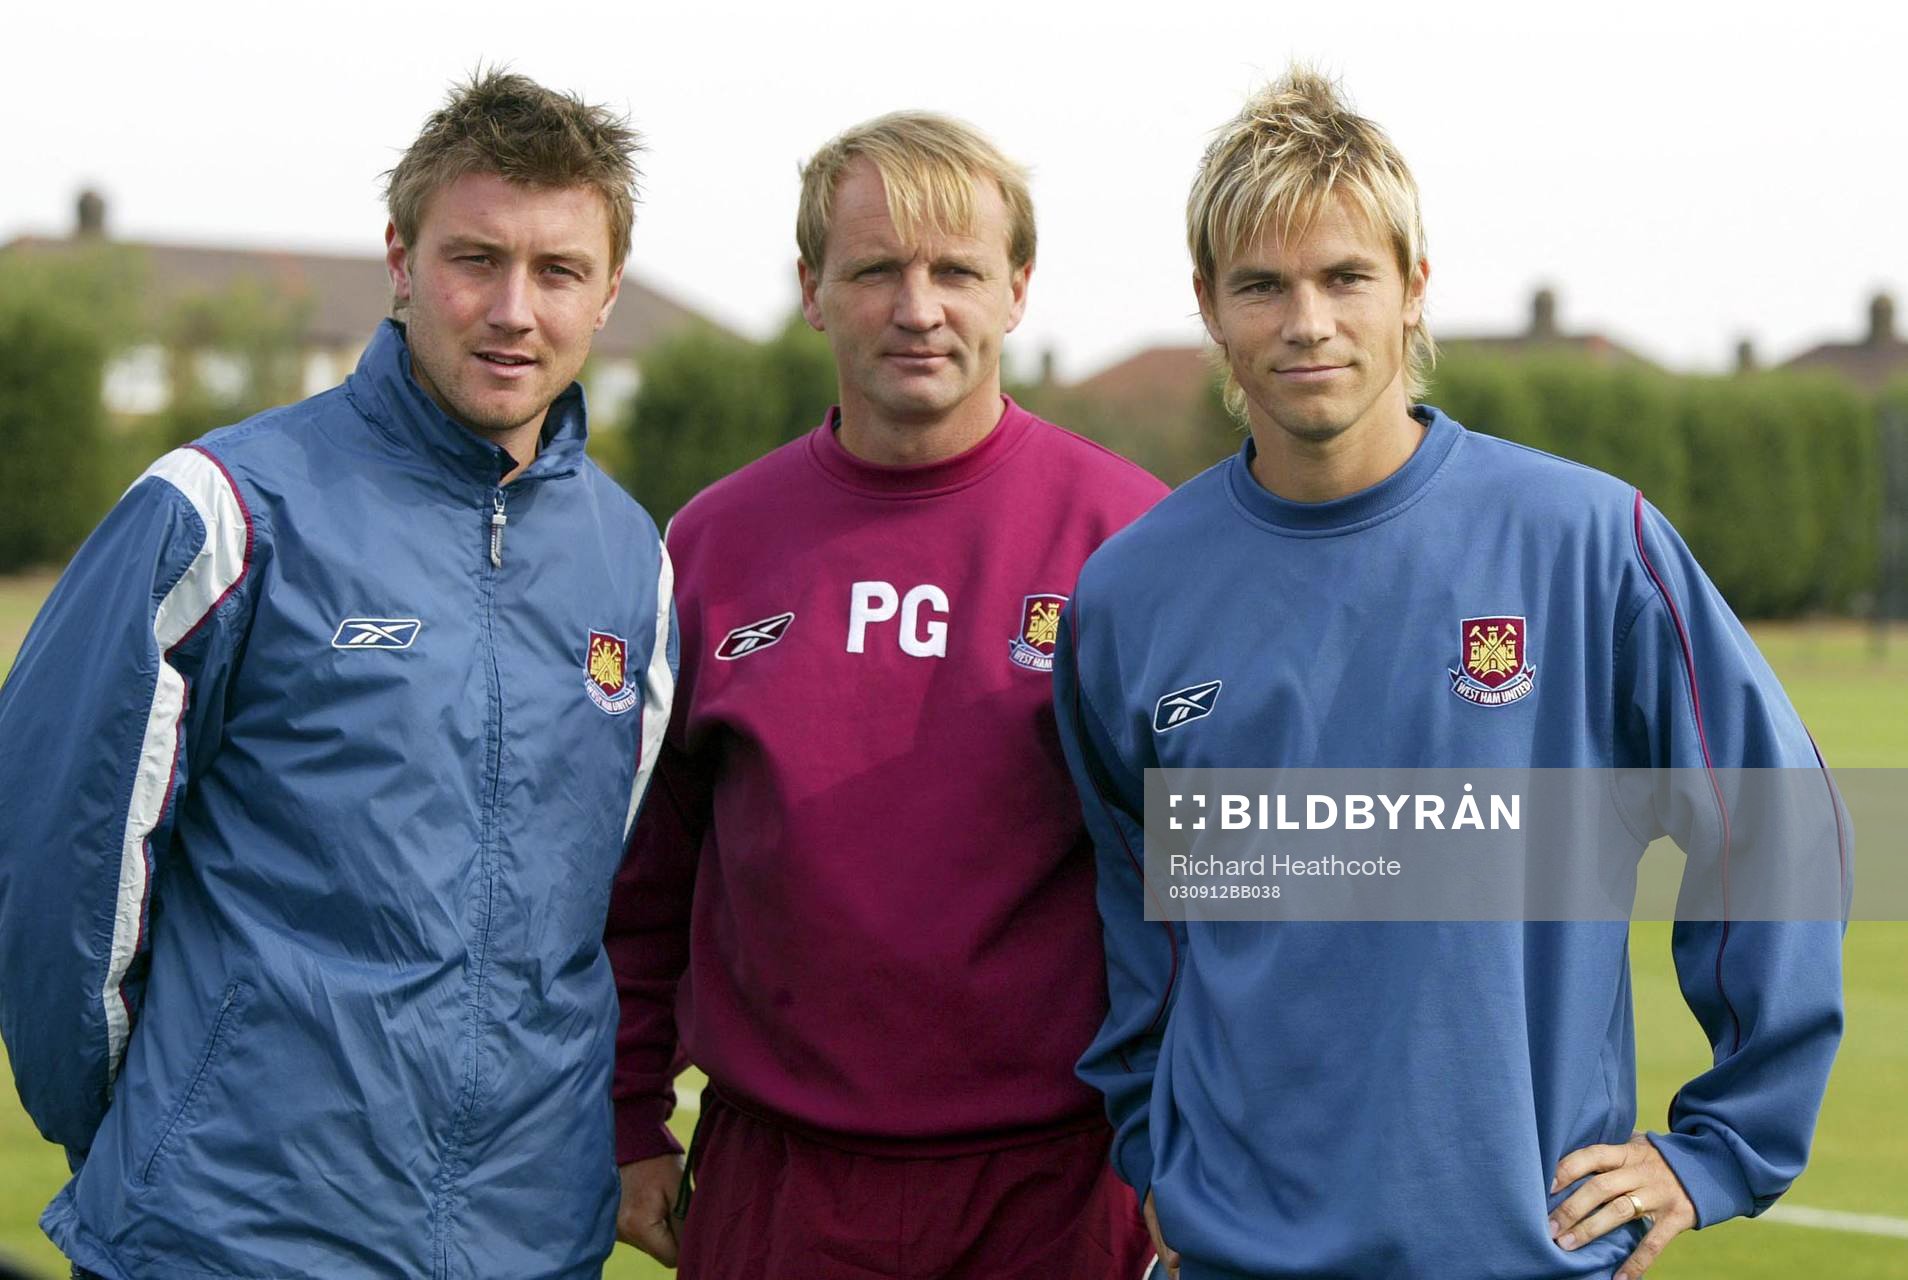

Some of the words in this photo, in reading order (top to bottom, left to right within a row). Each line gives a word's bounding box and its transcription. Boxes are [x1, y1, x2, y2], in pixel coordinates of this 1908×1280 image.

[846, 581, 950, 658] PG
[1456, 681, 1481, 702] WEST
[1480, 691, 1502, 704] HAM
[1501, 680, 1531, 703] UNITED
